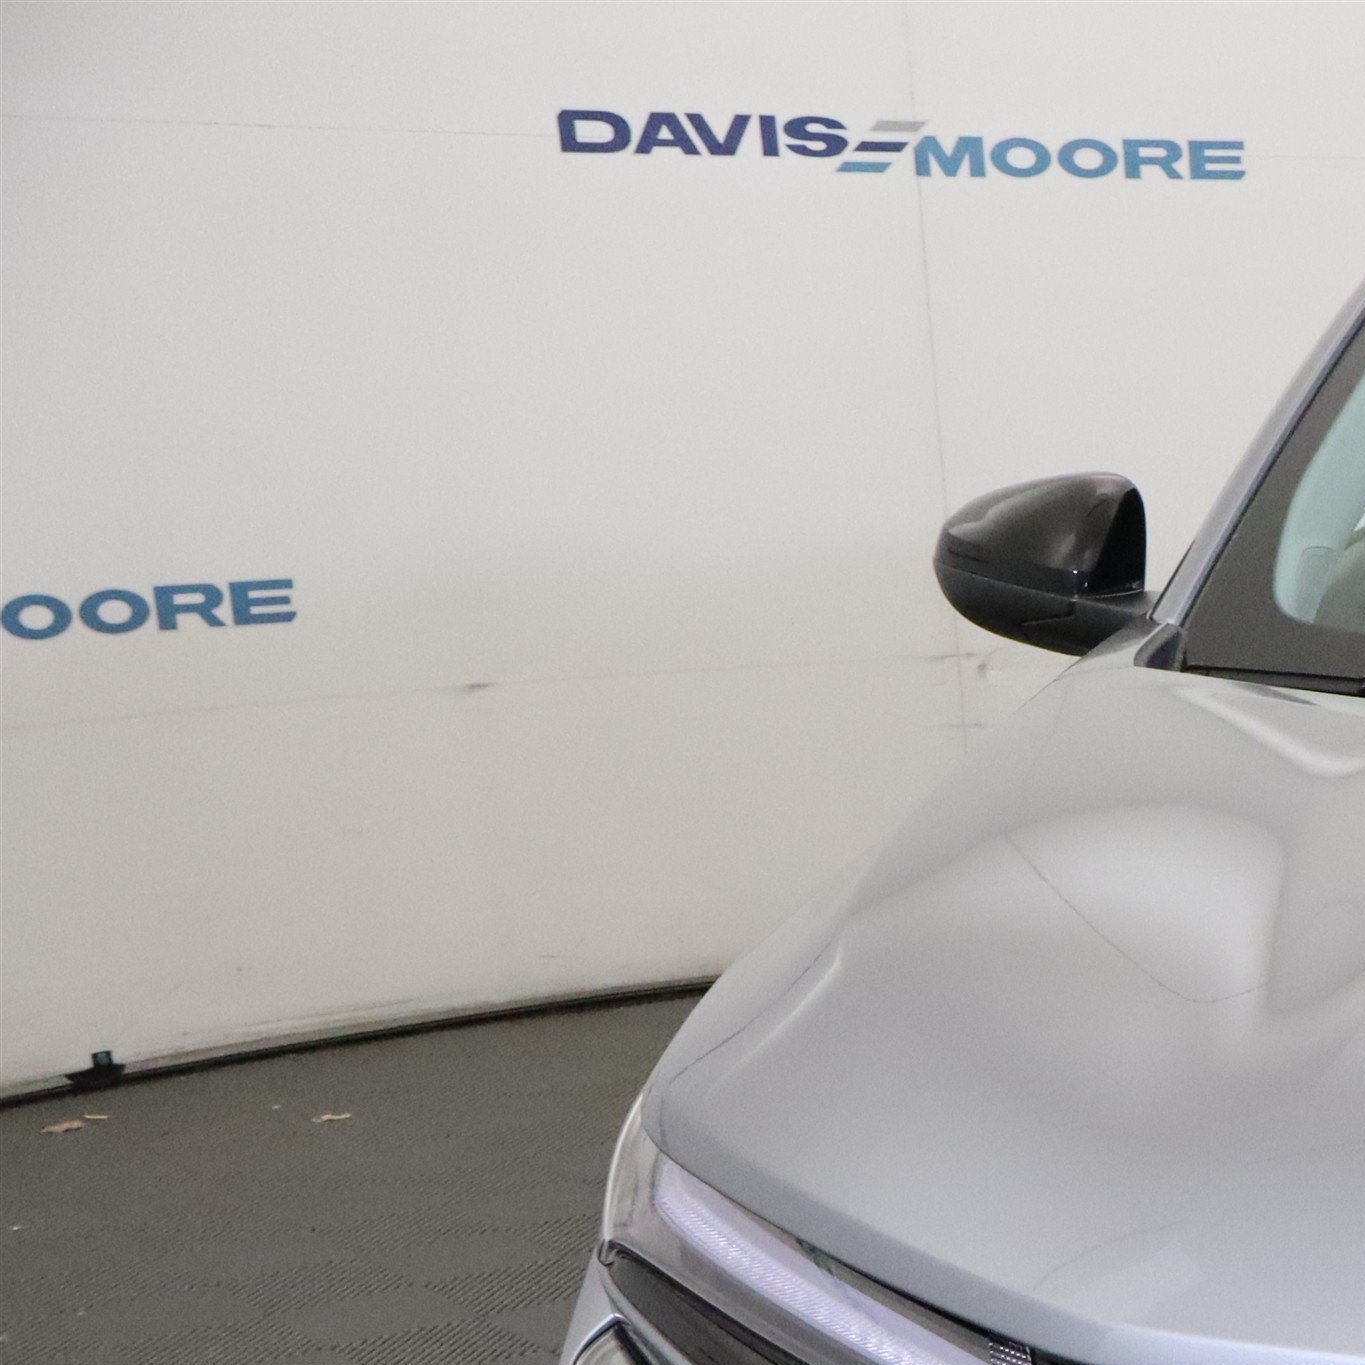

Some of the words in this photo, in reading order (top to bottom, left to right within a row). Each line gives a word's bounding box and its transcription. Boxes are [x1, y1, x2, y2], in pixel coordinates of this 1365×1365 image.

[559, 109, 846, 158] DAVIS
[914, 134, 1245, 181] MOORE
[0, 578, 297, 641] OORE
